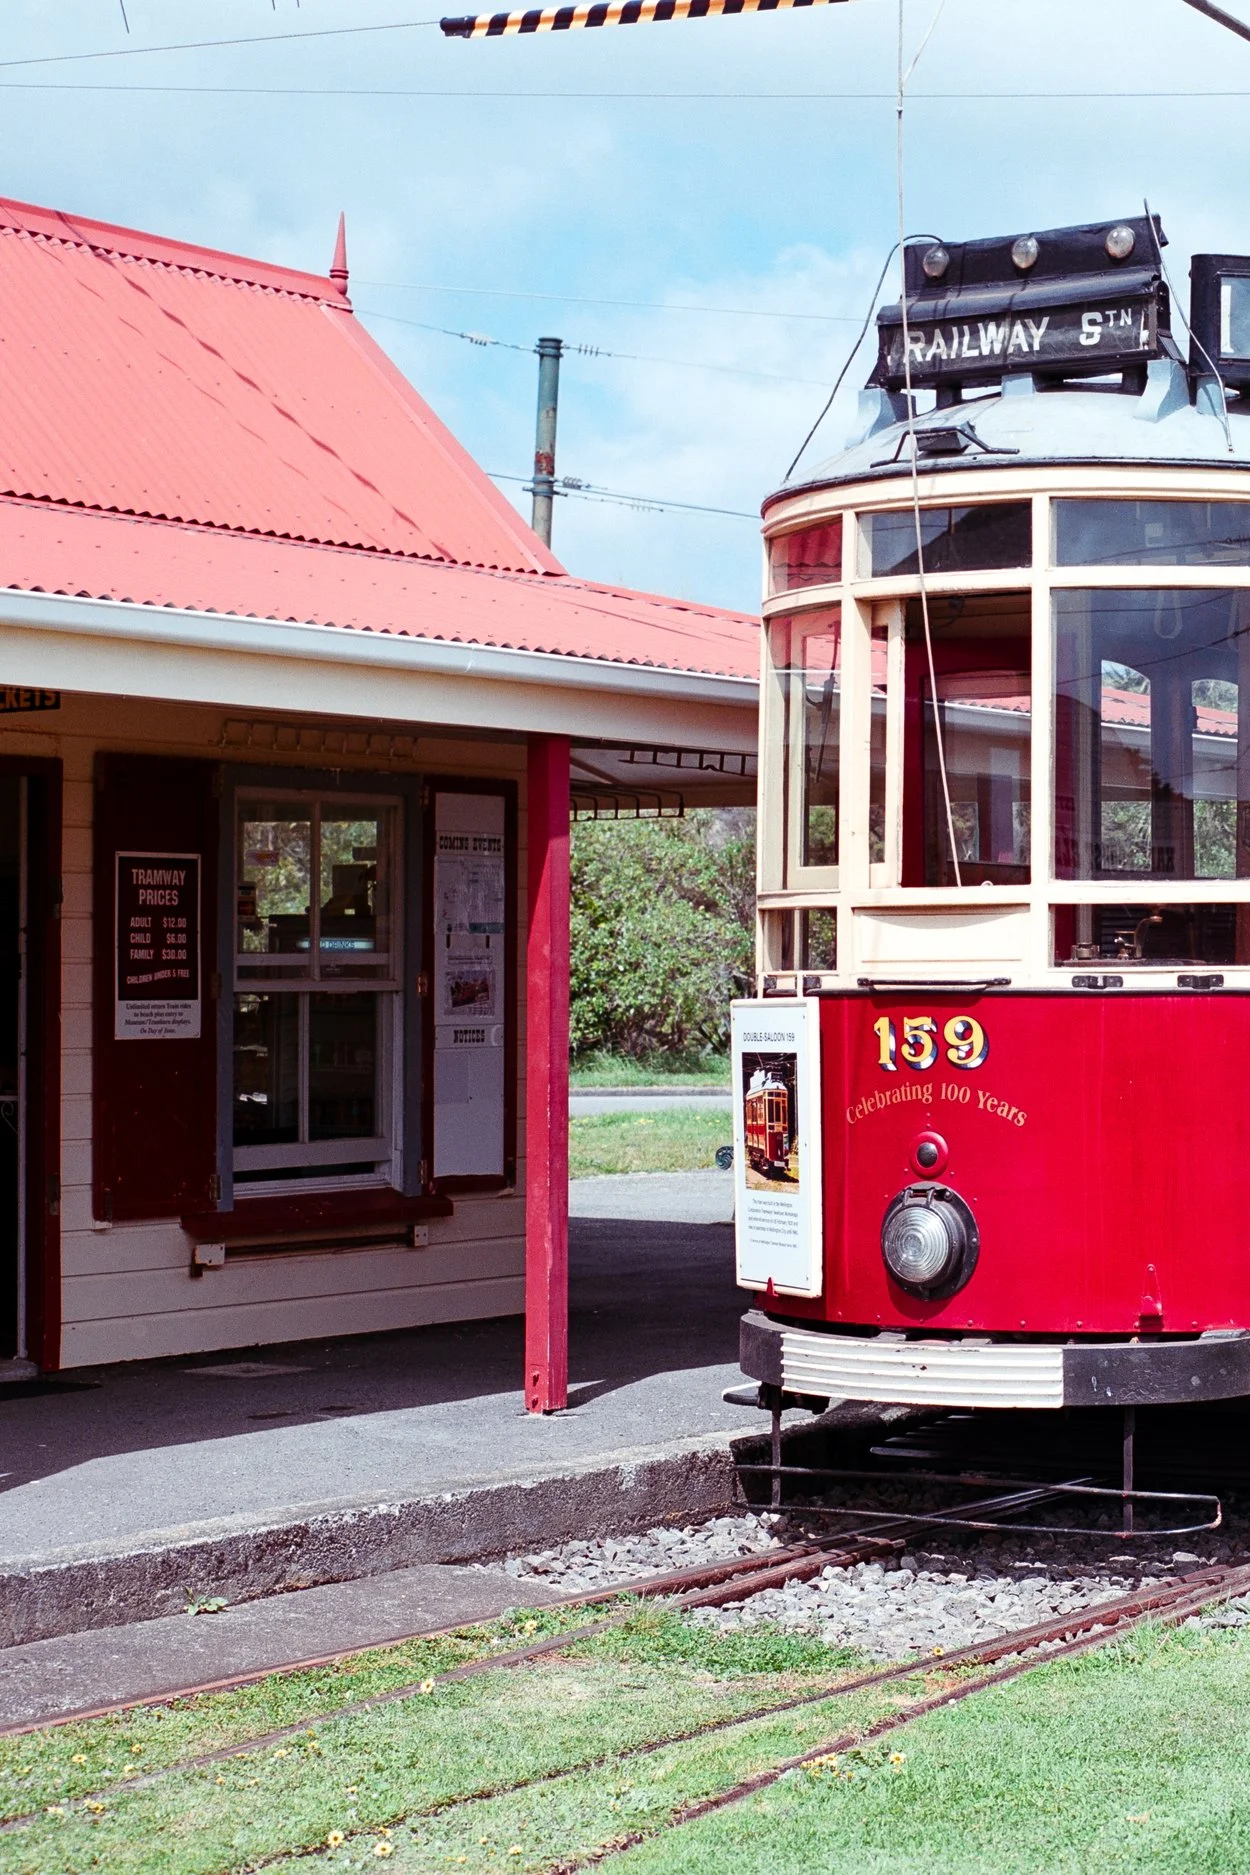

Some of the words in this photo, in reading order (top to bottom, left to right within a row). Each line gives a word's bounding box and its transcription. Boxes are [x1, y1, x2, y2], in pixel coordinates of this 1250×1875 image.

[904, 316, 1049, 361] RAILWAY
[439, 836, 469, 850] COMING
[472, 837, 502, 852] EVENTS
[131, 868, 186, 886] TRAMWAY
[138, 889, 179, 906] PRICES
[130, 917, 152, 928] ADULT
[162, 917, 187, 929] $12.00
[130, 933, 151, 944] CHILD
[166, 933, 187, 944] $6.00
[130, 949, 155, 960] FAMILY
[161, 949, 187, 960] $30.00
[126, 973, 153, 985] CHILDREN
[154, 969, 171, 981] UNDER
[177, 969, 190, 978] FREE
[453, 1029, 485, 1043] NOTICES
[873, 1015, 990, 1071] 159
[846, 1082, 933, 1125] Celebrating
[940, 1082, 971, 1104] 100
[976, 1089, 1028, 1127] Years
